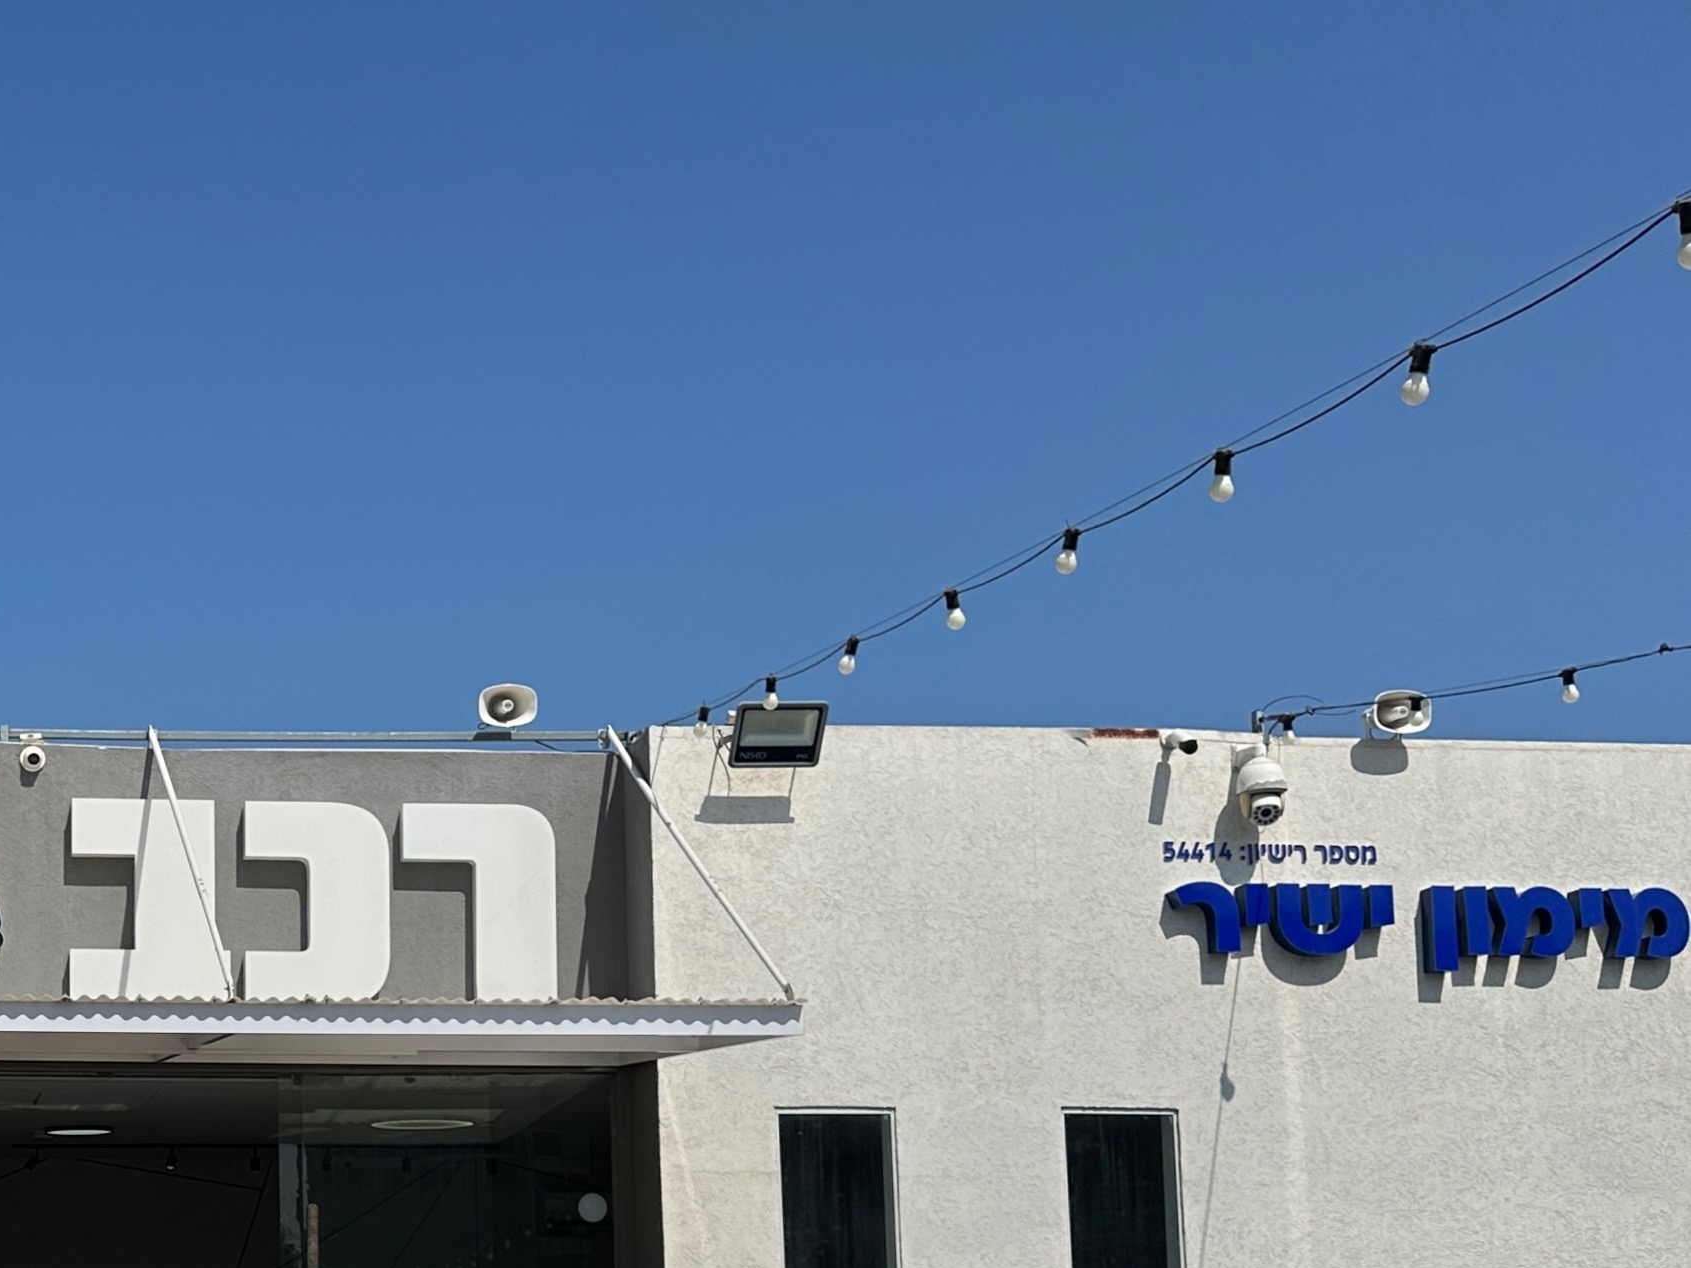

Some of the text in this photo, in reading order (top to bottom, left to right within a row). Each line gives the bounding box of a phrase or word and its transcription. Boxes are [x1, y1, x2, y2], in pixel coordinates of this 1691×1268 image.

[69, 797, 559, 1001] רכב
[1162, 841, 1377, 866] מספר רישיון: 54414
[1164, 880, 1690, 974] מימון ישיר
